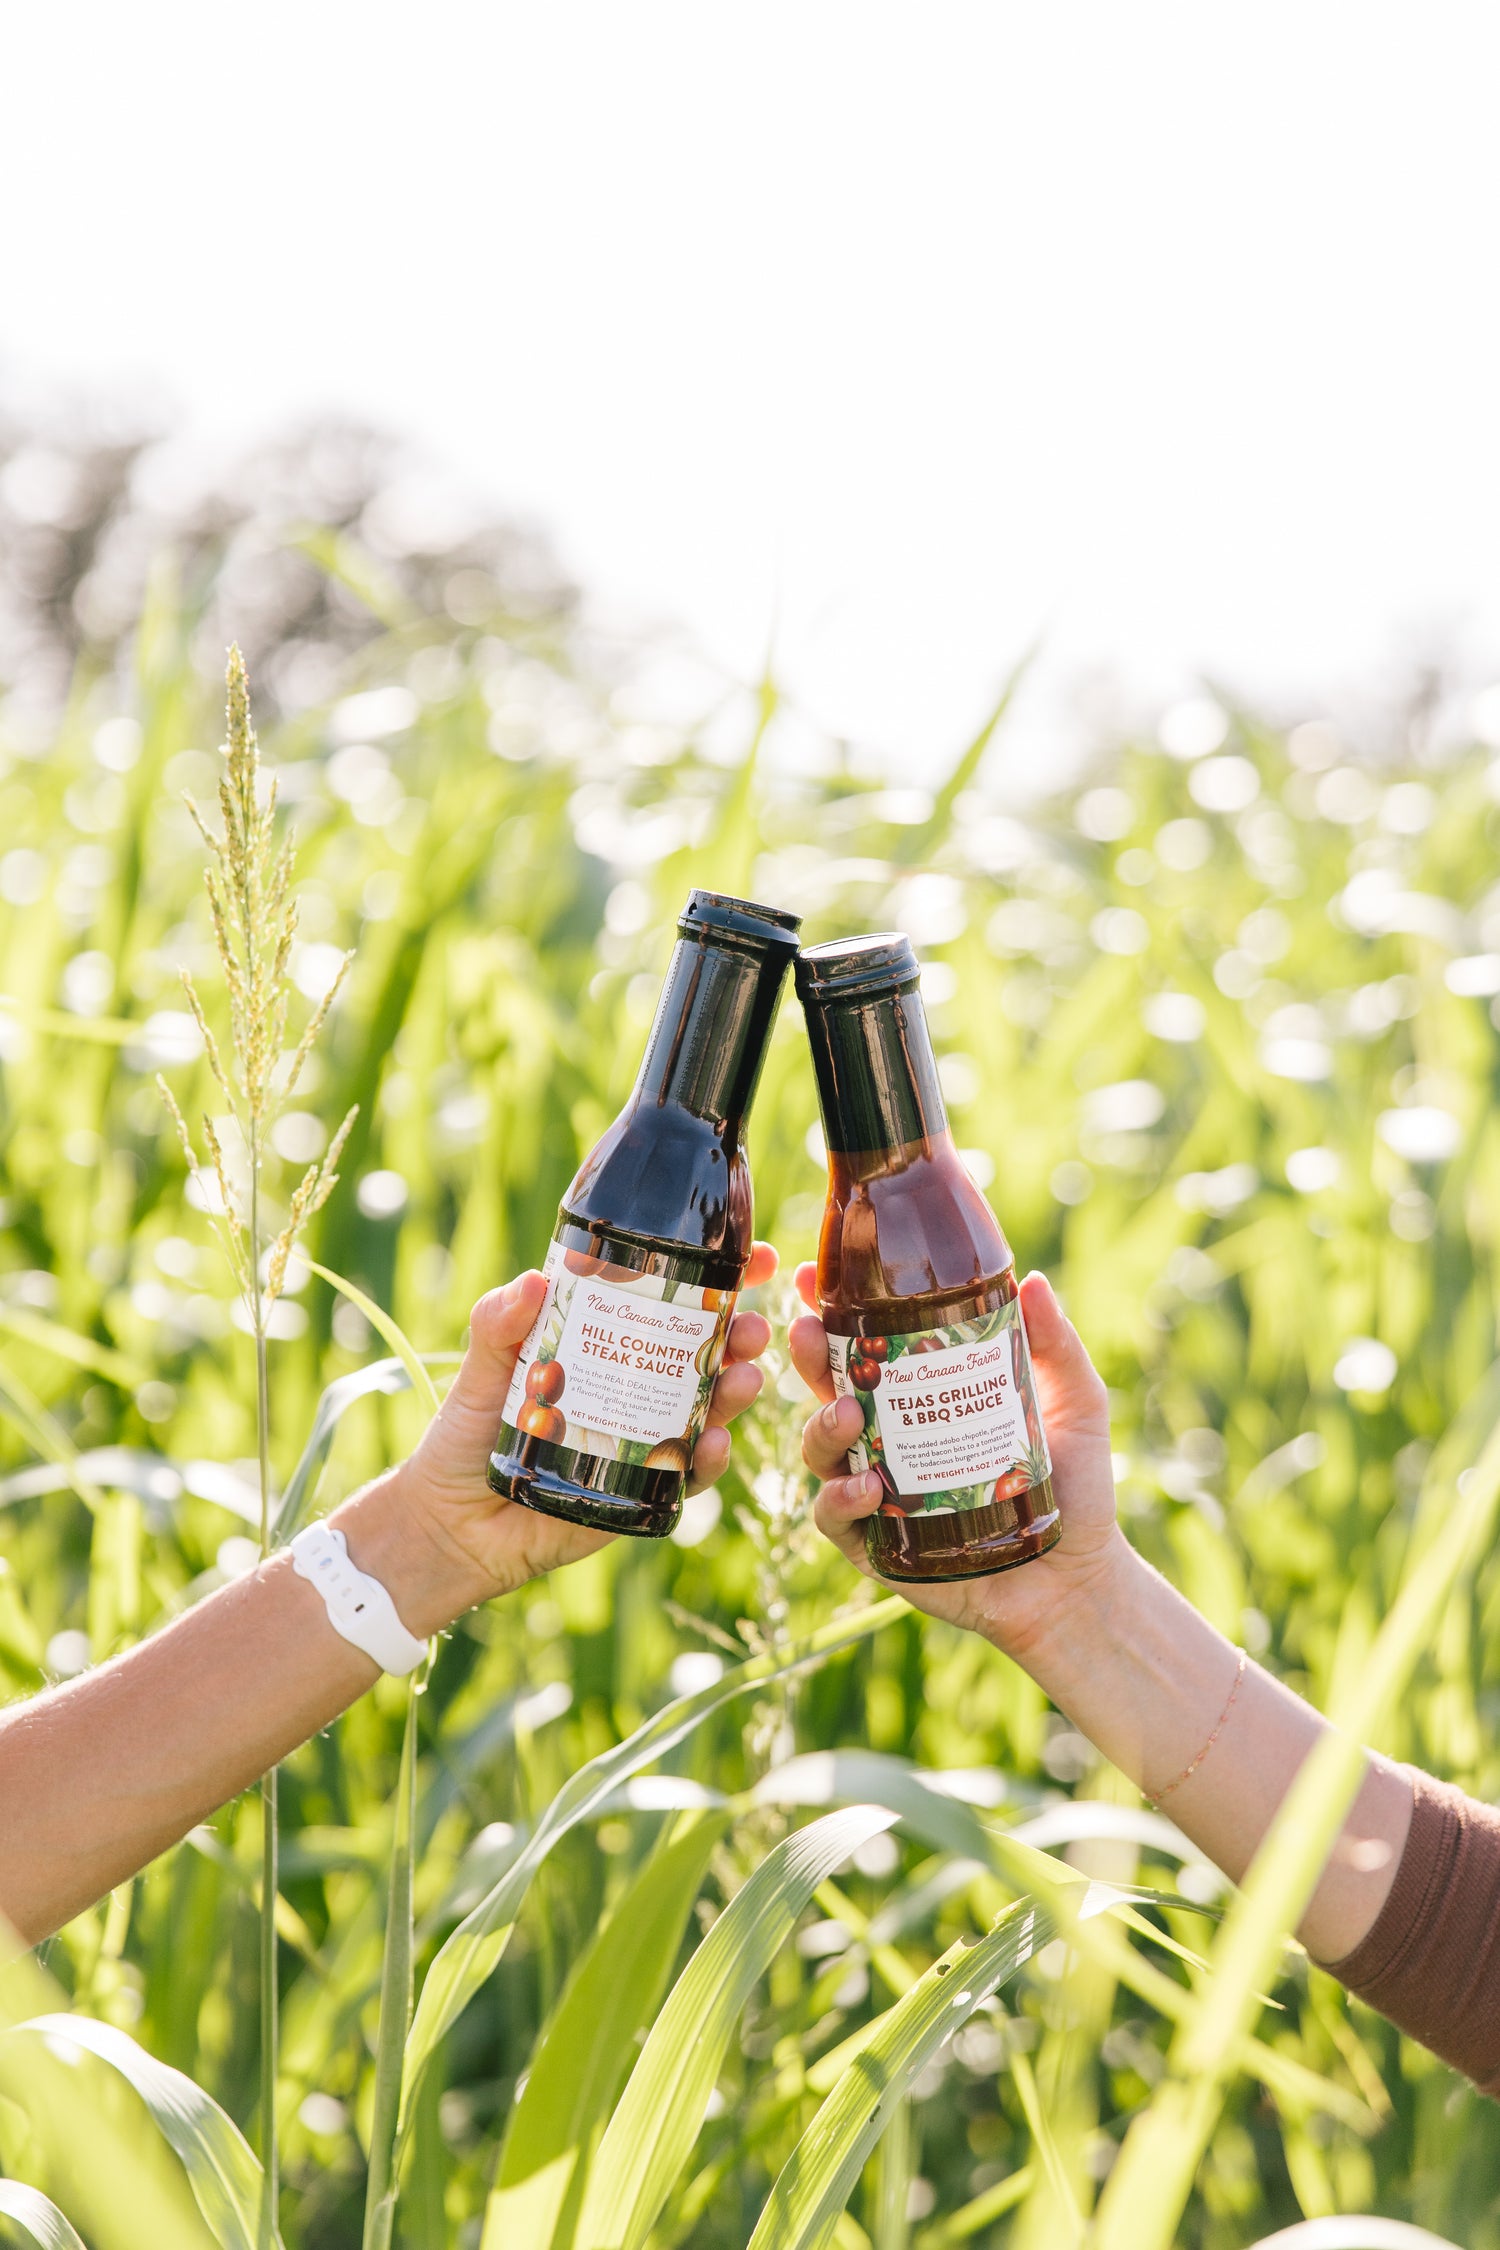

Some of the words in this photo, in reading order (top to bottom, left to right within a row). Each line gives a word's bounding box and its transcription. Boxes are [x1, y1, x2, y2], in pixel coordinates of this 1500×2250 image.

[588, 1294, 615, 1314] New
[617, 1304, 664, 1328] Canaan
[666, 1316, 703, 1336] Farms
[582, 1323, 615, 1344] HILL
[620, 1336, 694, 1362] COUNTRY
[582, 1342, 632, 1366] STEAK
[635, 1357, 684, 1378] SAUCE
[885, 1369, 913, 1383] New
[917, 1365, 964, 1380] Canaan
[967, 1347, 1000, 1370] Farms
[569, 1375, 584, 1384] your
[586, 1379, 611, 1392] favorite
[634, 1393, 652, 1403] steak,
[571, 1363, 584, 1374] This
[585, 1368, 590, 1376] is
[592, 1370, 602, 1379] the
[605, 1374, 624, 1385] REAL
[627, 1380, 651, 1392] DEAL!
[652, 1386, 669, 1396] Serve
[670, 1390, 681, 1398] with
[888, 1395, 934, 1410] TEJAS
[939, 1374, 1007, 1403] GRILLING
[577, 1386, 604, 1400] flavorful
[604, 1396, 627, 1409] grilling
[629, 1403, 647, 1412] sauce
[648, 1404, 658, 1413] for
[658, 1408, 672, 1417] pork
[611, 1406, 638, 1419] chicken.
[903, 1414, 913, 1425] &
[917, 1408, 951, 1424] BBQ
[955, 1393, 1003, 1417] SAUCE
[571, 1410, 586, 1419] NET
[588, 1414, 618, 1428] WEIGHT
[620, 1424, 638, 1433] 15.5G
[643, 1429, 661, 1438] 444G
[896, 1442, 916, 1450] We've
[918, 1440, 938, 1448] added
[940, 1437, 960, 1446] adobo
[962, 1430, 989, 1441] chipotle,
[991, 1419, 1015, 1434] pineapple
[901, 1453, 916, 1462] juice
[954, 1444, 966, 1452] bits
[981, 1435, 1002, 1445] tomato
[1004, 1430, 1015, 1438] base
[920, 1456, 954, 1468] bodacious
[955, 1450, 980, 1462] burgers
[981, 1447, 992, 1456] and
[994, 1441, 1012, 1452] brisket
[934, 1468, 966, 1478] WEIGHT
[966, 1462, 990, 1473] 14.5OZ
[994, 1455, 1011, 1465] 410G
